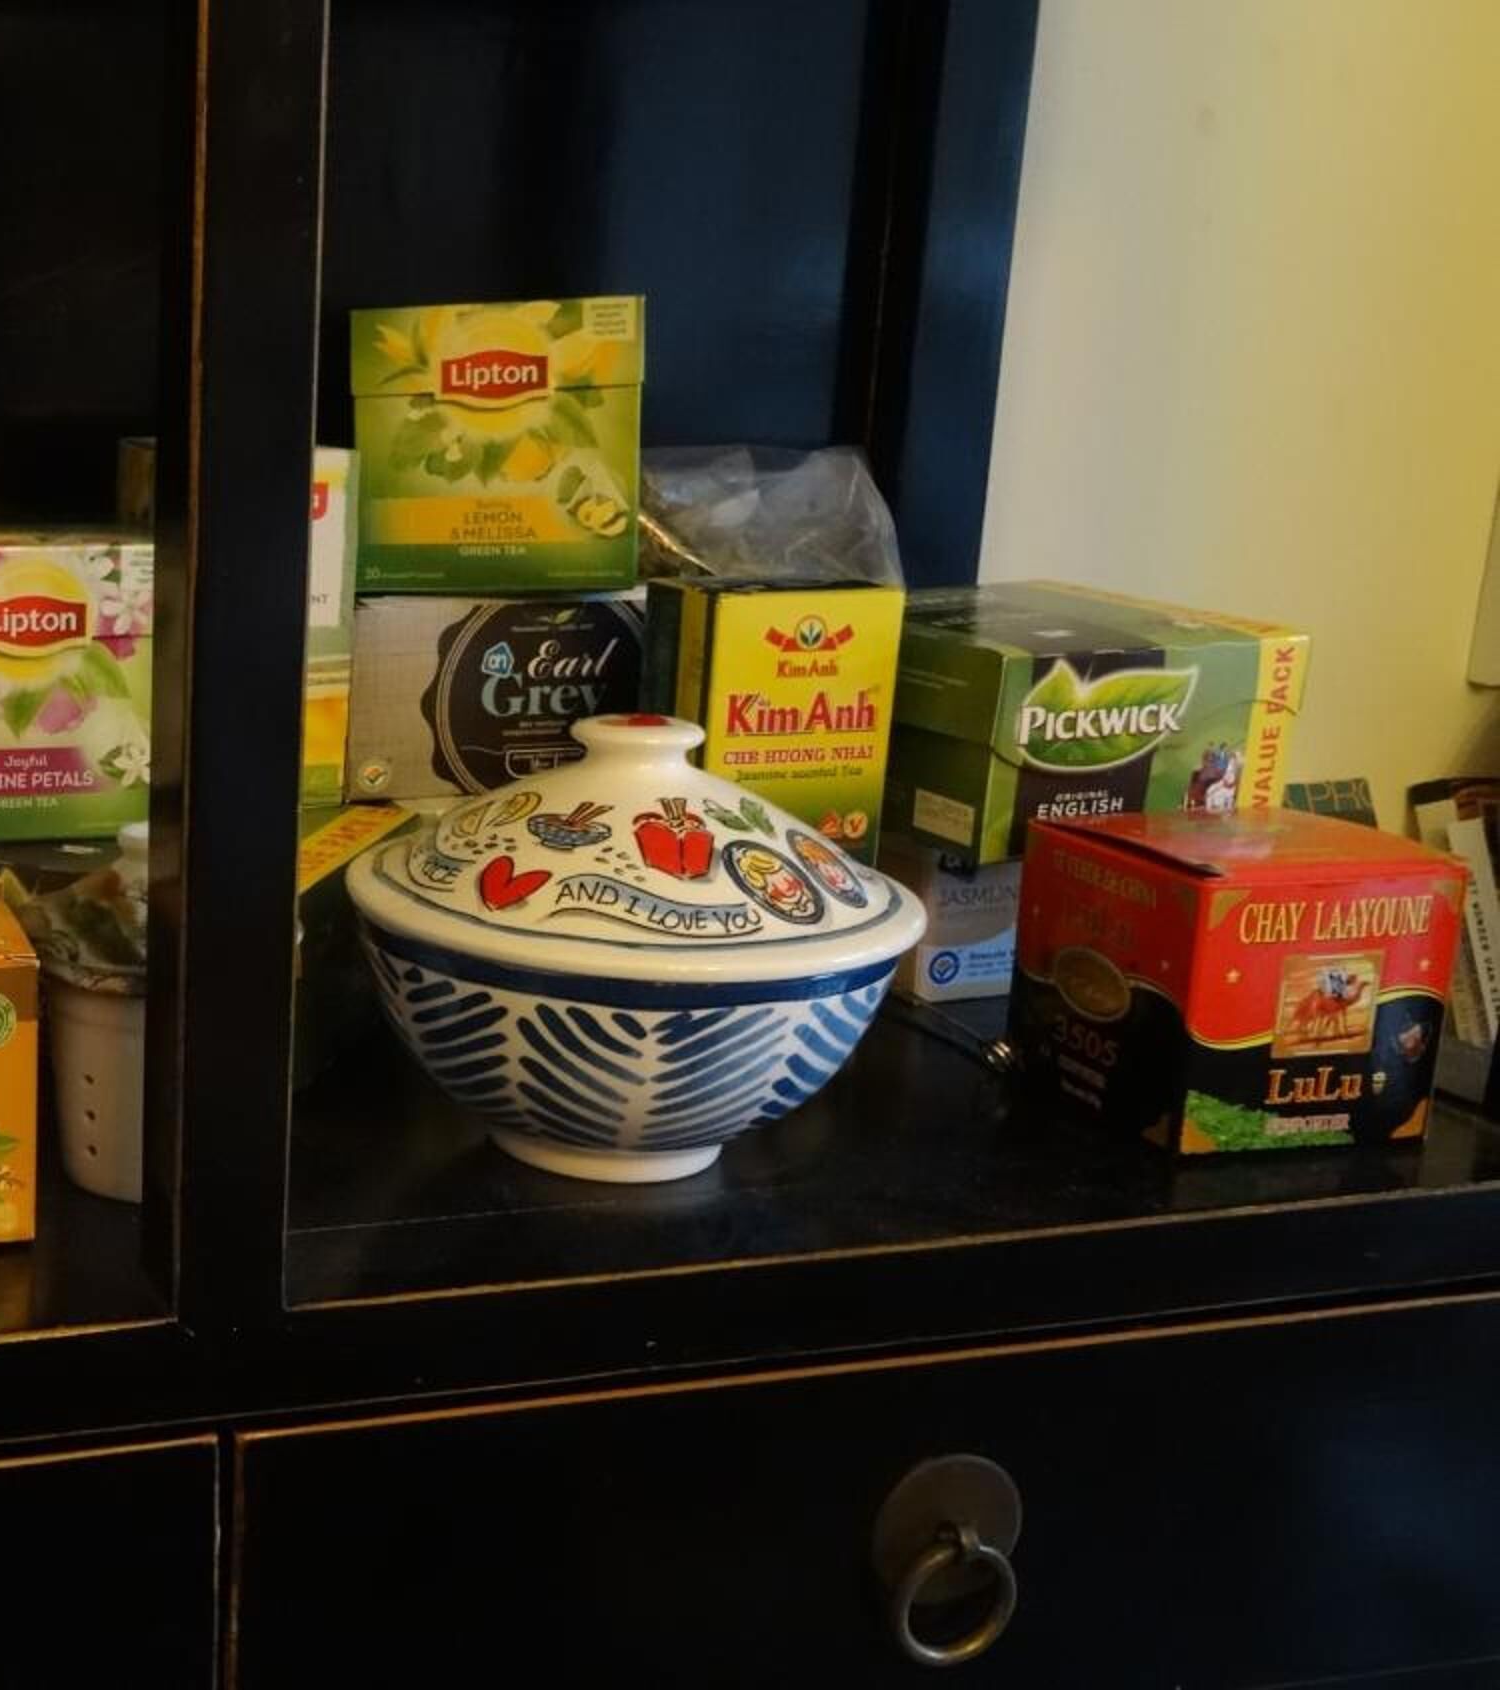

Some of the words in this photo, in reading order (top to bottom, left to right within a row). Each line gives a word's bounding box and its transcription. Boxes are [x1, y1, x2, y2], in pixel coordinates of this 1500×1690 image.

[450, 363, 539, 390] Lipton
[463, 511, 524, 525] LEMON
[527, 637, 621, 680] Earl
[776, 660, 806, 678] Kim
[807, 658, 838, 676] Anh
[481, 672, 606, 717] Grey
[1266, 645, 1297, 718] PACK
[726, 692, 800, 736] Kim
[803, 689, 877, 732] Anh
[1018, 702, 1182, 746] PICKWICK
[3, 754, 49, 771] Joyful
[723, 750, 759, 765] CHE
[1252, 726, 1282, 812] VALUE
[31, 770, 95, 788] PETALS
[36, 797, 59, 809] TEA
[1036, 796, 1125, 820] ENGLISH
[555, 882, 619, 905] AND
[628, 894, 640, 916] I
[649, 906, 707, 930] LOVE
[711, 908, 762, 933] YOU
[1238, 903, 1307, 945] CHAY
[1314, 895, 1436, 942] LAAYOUNE
[1263, 1065, 1362, 1105] LuLu
